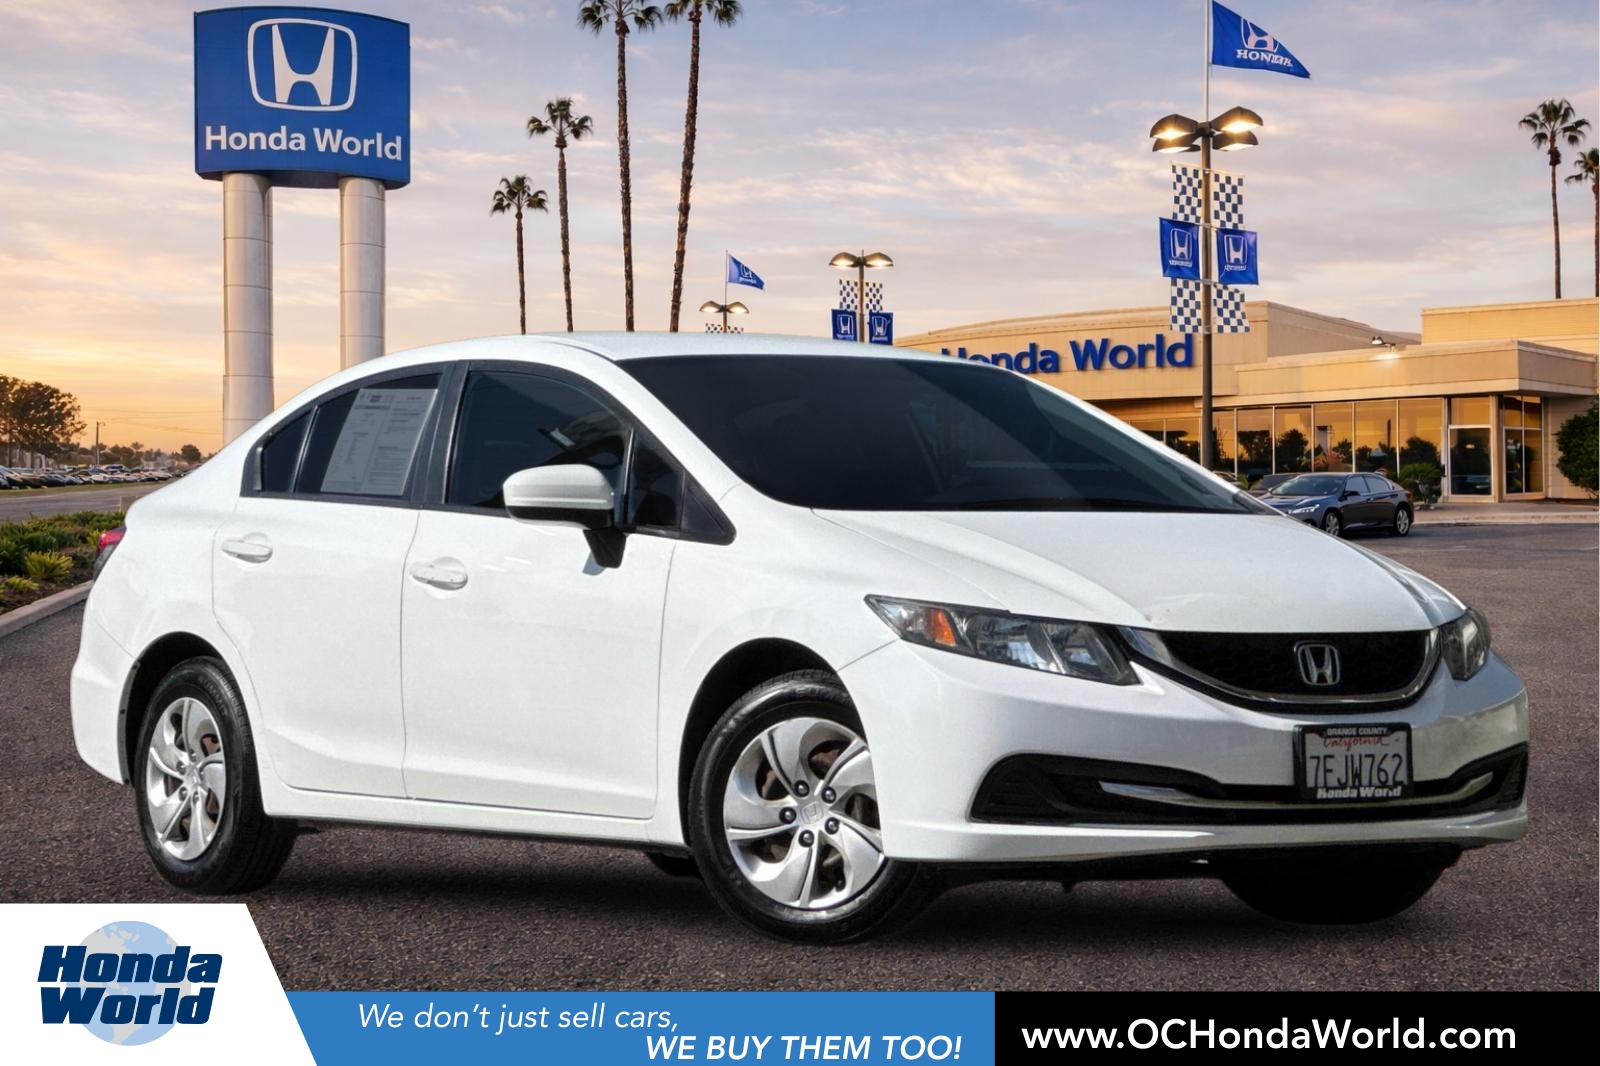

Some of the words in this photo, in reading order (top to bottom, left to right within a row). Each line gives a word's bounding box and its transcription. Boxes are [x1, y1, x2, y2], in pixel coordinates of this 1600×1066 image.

[205, 125, 306, 151] Honda
[313, 127, 402, 161] World
[1070, 333, 1194, 371] World
[1359, 727, 1388, 736] COUNTY
[1316, 787, 1358, 799] Honda
